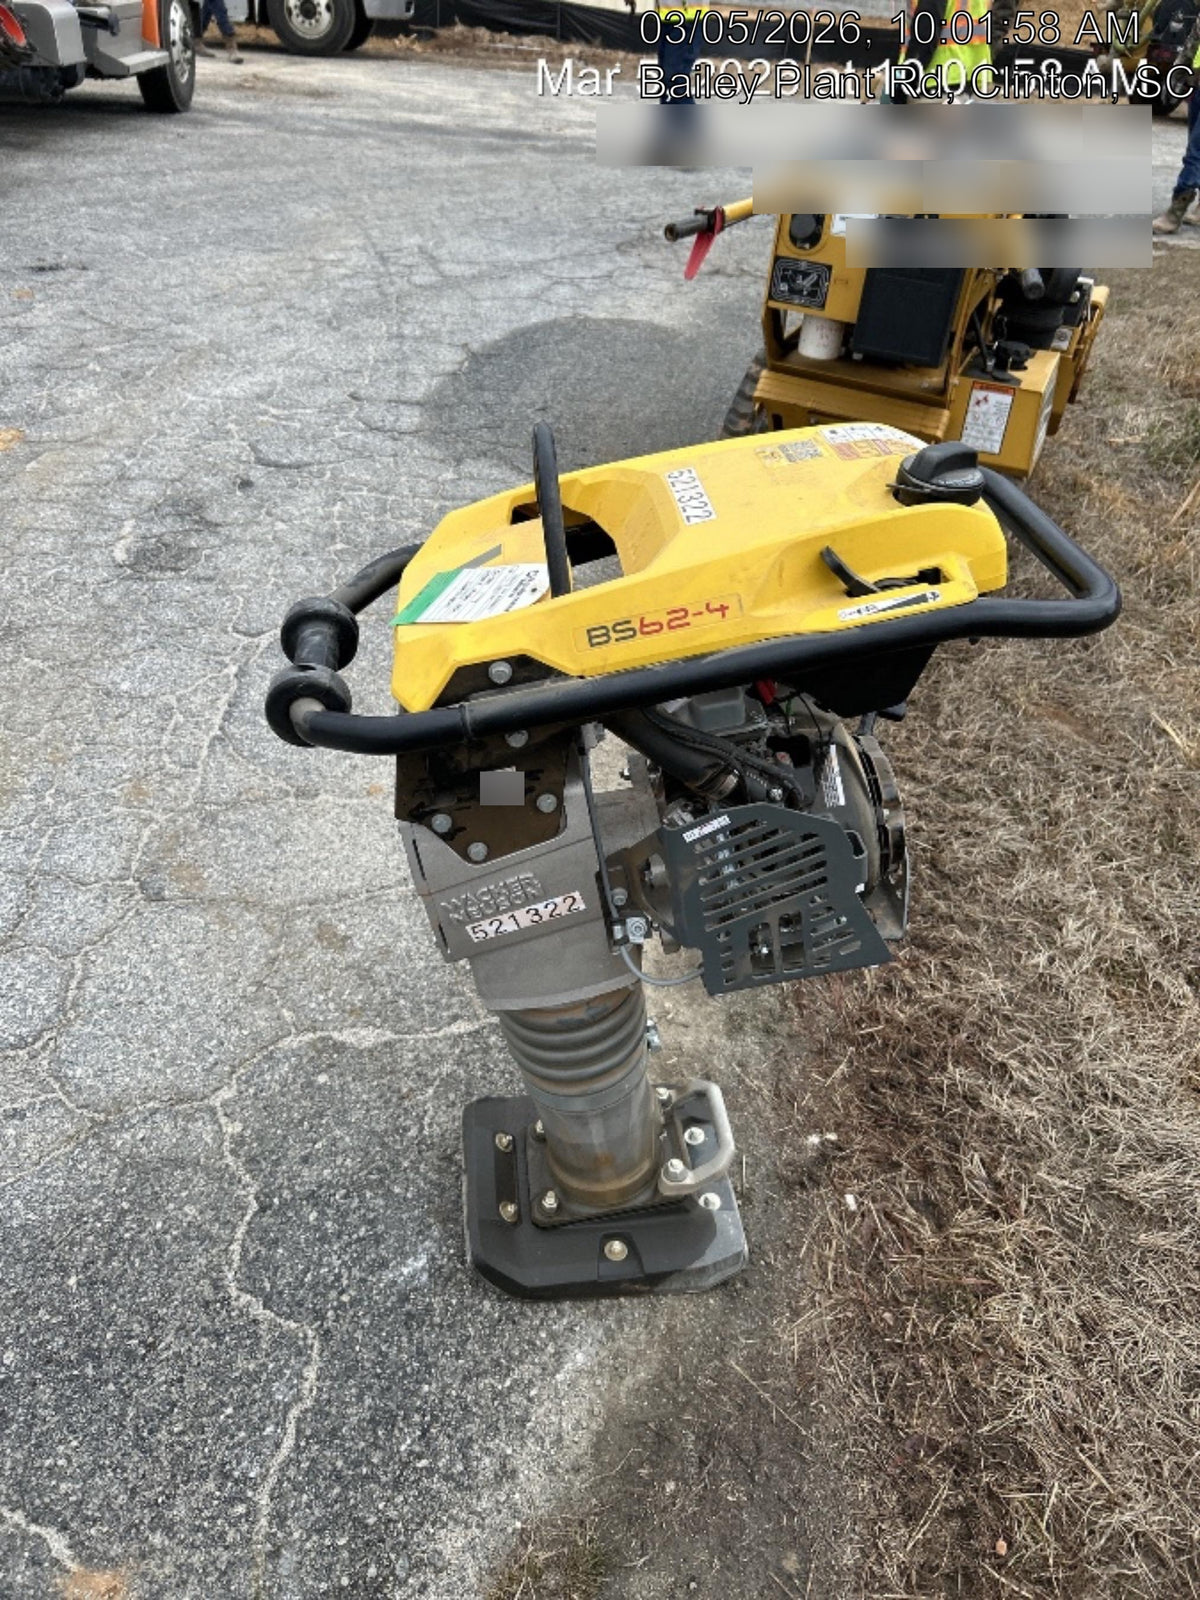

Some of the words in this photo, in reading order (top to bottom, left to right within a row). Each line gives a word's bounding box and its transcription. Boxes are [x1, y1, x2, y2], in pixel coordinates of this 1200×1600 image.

[667, 468, 713, 524] 521322
[586, 602, 730, 648] BS62-4
[471, 894, 582, 941] 521322
